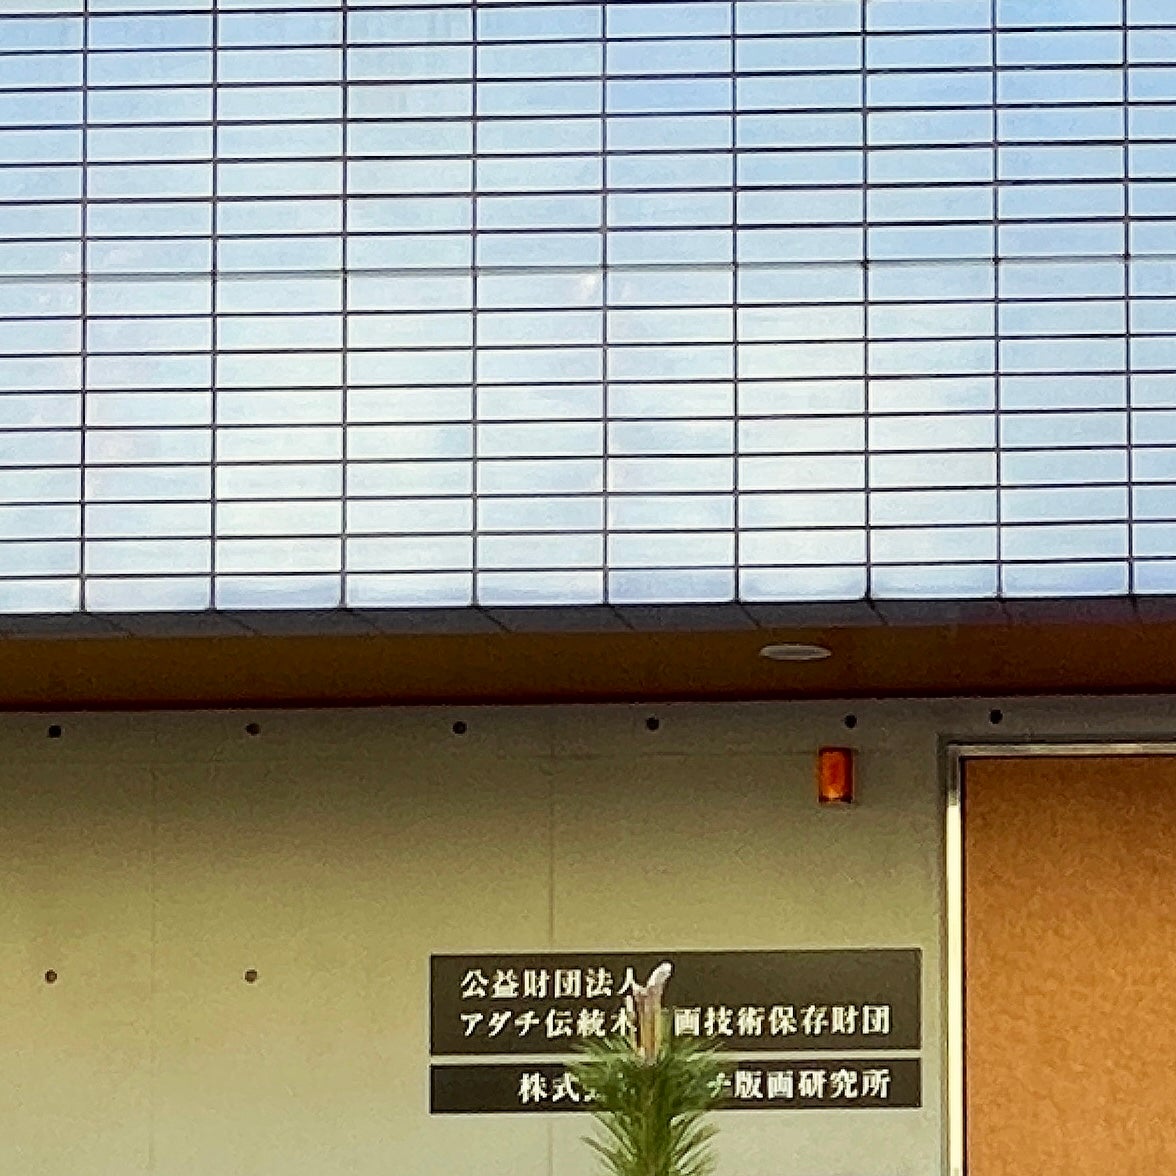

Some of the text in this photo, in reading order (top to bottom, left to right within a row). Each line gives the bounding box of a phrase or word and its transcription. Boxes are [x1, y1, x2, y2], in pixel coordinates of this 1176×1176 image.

[460, 967, 648, 999] 公益財団法人
[460, 1004, 891, 1037] アダチ伝統木画技術保存財団
[519, 1068, 891, 1104] 株式チ版画研究所
